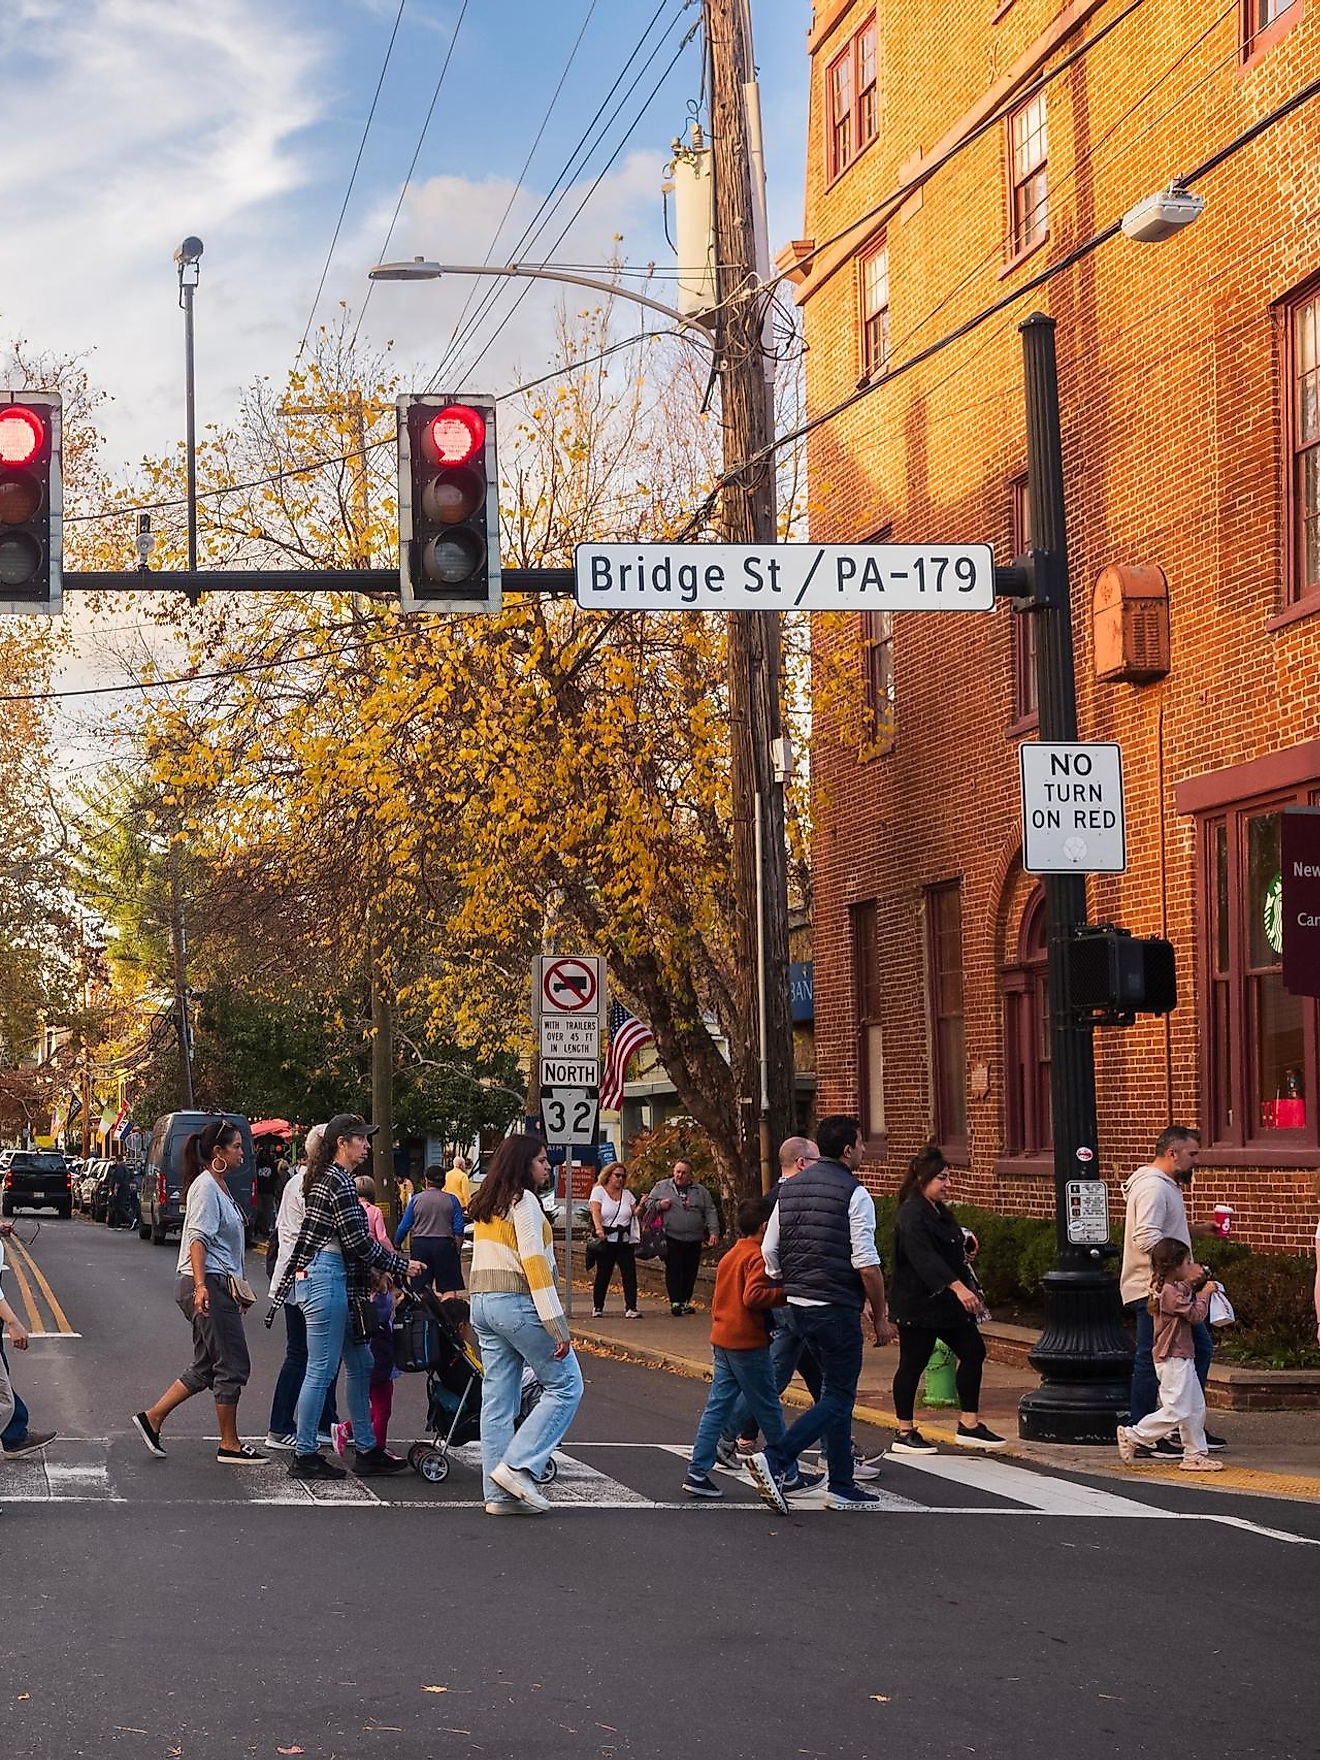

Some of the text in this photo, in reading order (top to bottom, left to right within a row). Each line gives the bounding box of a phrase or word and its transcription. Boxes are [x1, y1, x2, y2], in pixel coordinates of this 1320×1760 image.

[591, 555, 725, 602] Bridge
[744, 556, 782, 593] St
[837, 556, 977, 593] PA-179
[1050, 753, 1092, 776] NO
[1043, 783, 1102, 802] TURN
[1032, 809, 1116, 829] ON RED
[1293, 861, 1320, 877] New
[544, 1021, 596, 1030] WITH TRAILERS
[546, 1032, 594, 1041] OVER 45 FT
[550, 1044, 590, 1053] IN LENGTH
[545, 1063, 595, 1082] NORTH
[547, 1101, 591, 1133] 32
